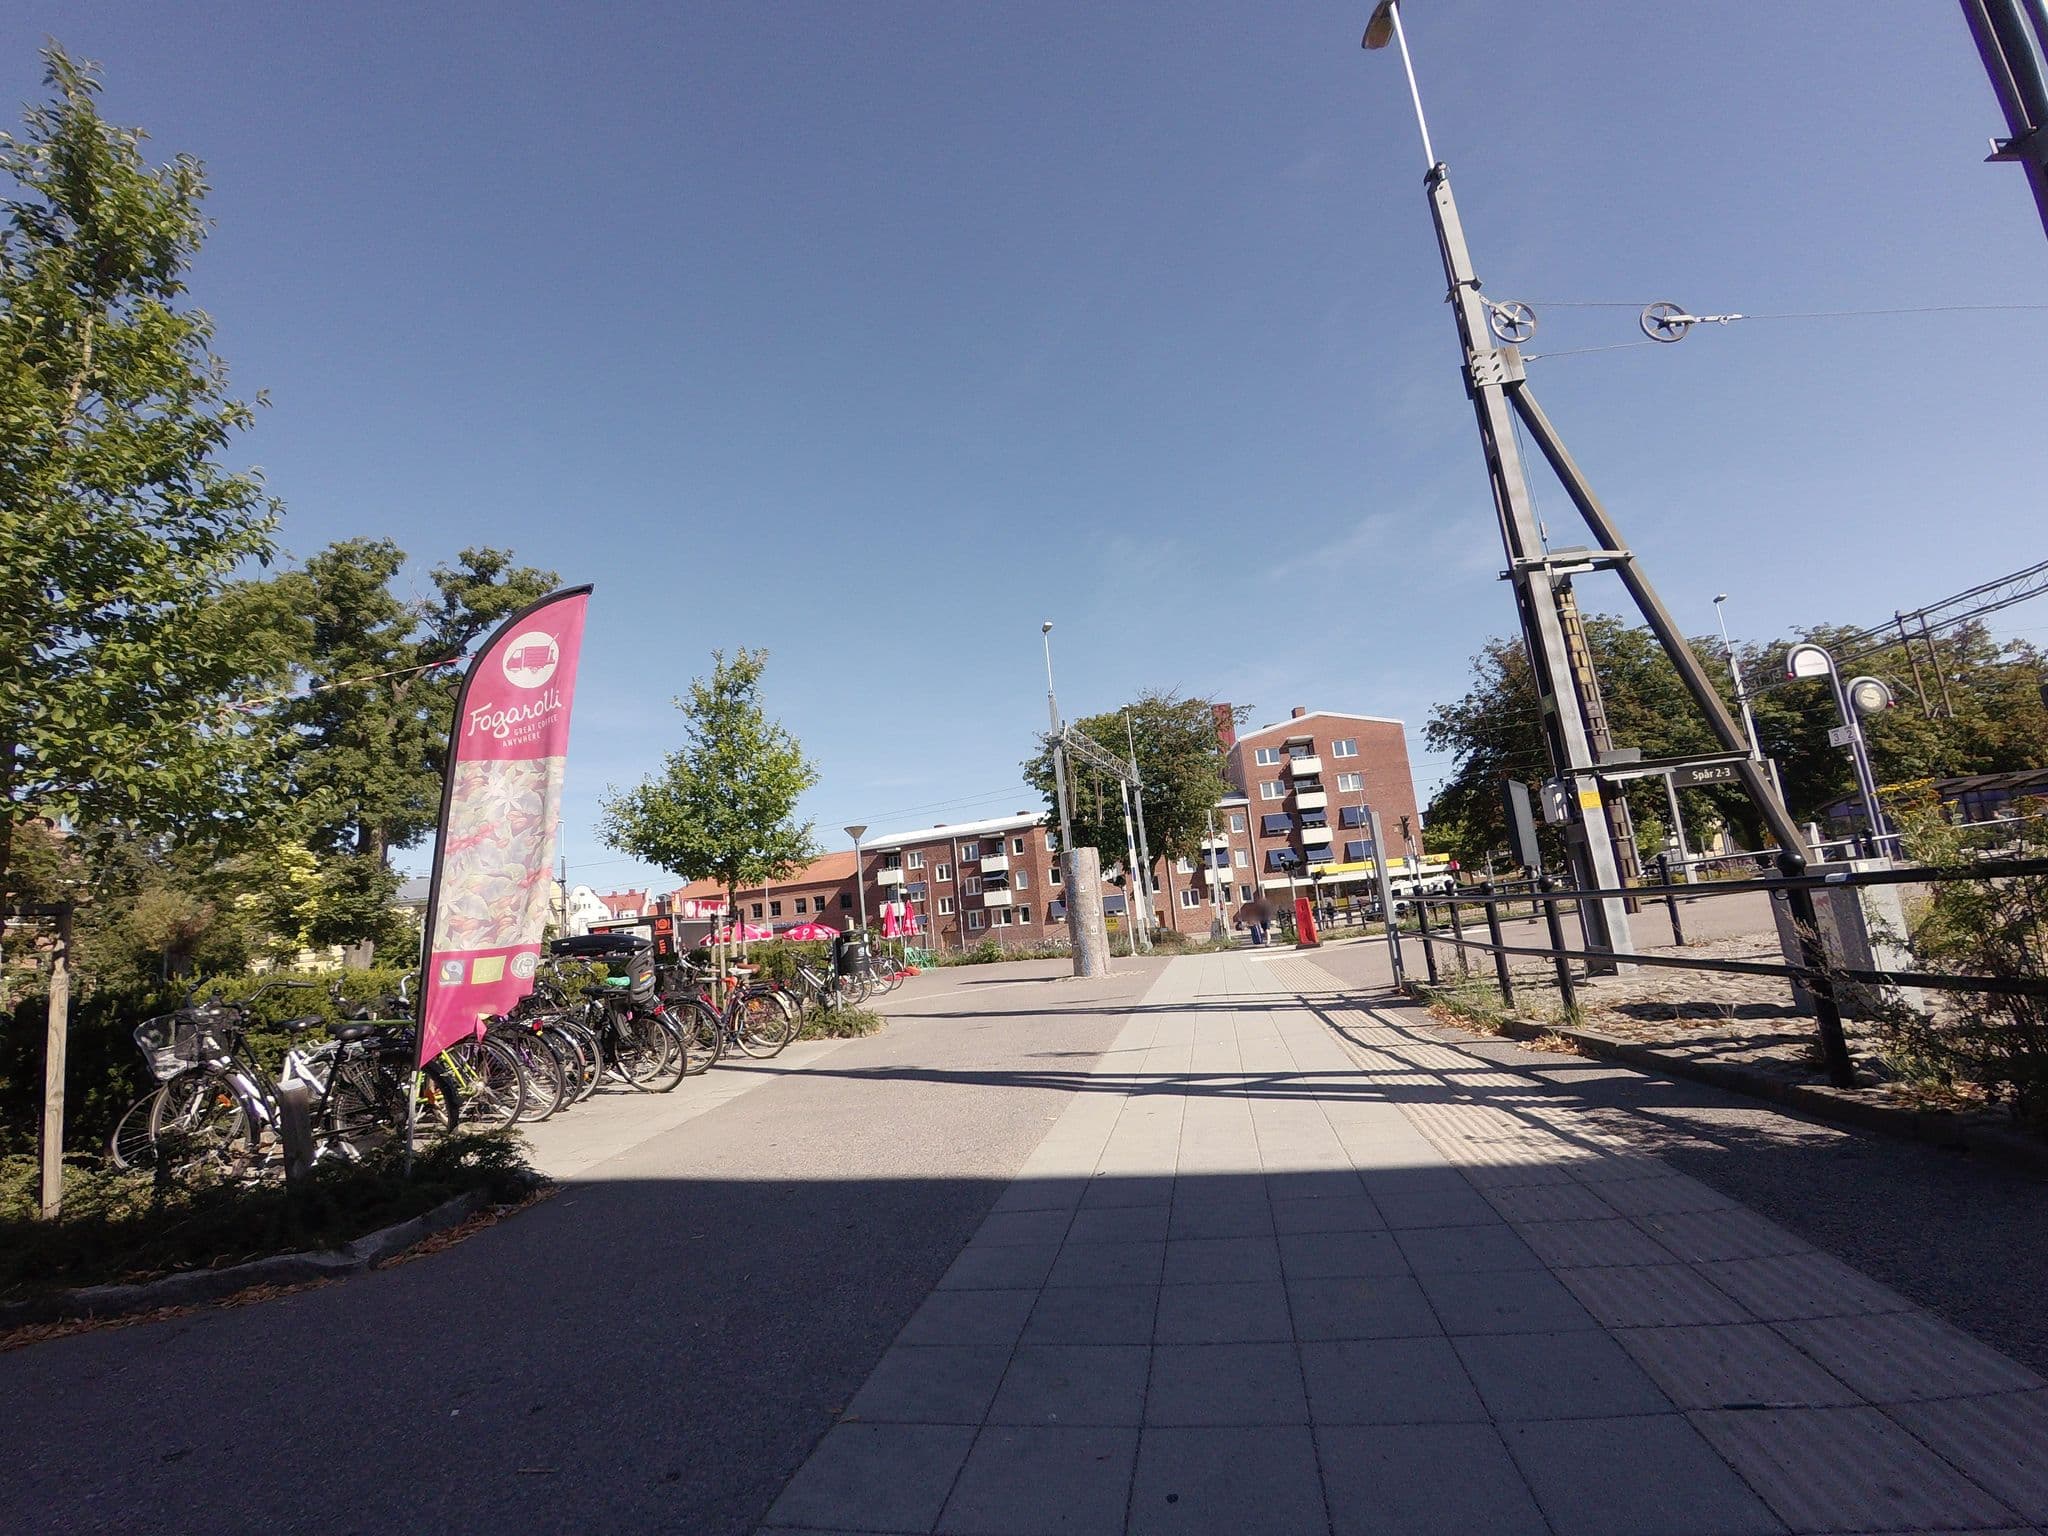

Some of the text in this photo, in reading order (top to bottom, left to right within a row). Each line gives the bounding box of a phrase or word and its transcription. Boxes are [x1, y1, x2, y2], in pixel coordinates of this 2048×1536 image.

[467, 688, 562, 738] Fogarolli
[514, 724, 535, 736] GREAT
[1833, 733, 1840, 742] 3
[1846, 730, 1854, 738] 2
[502, 731, 540, 748] ANYWHERE
[1692, 767, 1731, 781] Spår 2-3
